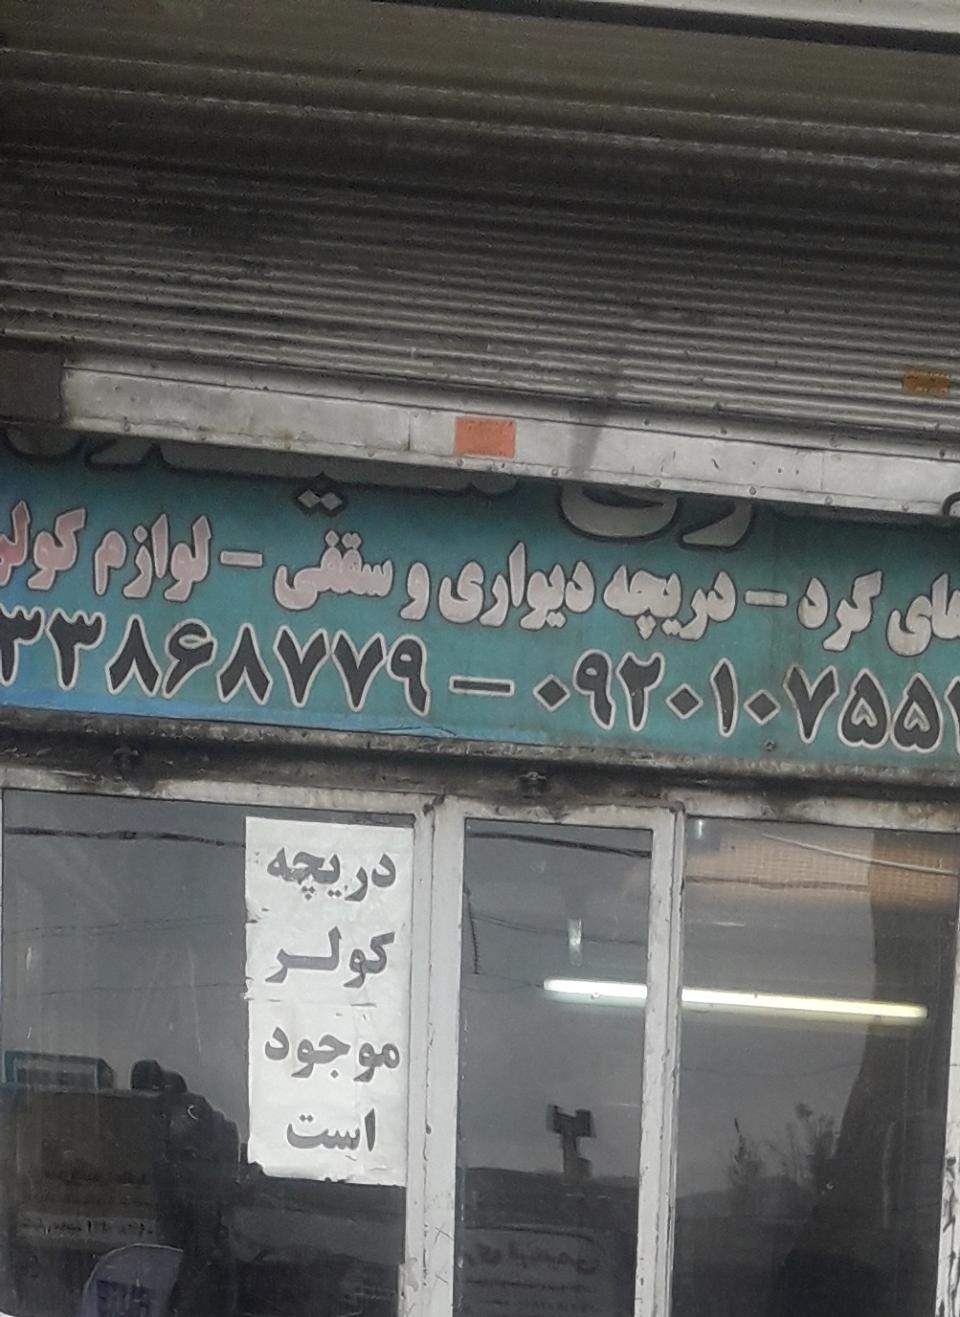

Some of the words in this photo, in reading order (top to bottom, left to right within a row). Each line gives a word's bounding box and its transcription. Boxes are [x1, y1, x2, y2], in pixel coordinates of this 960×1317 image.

[94, 512, 213, 603] لوازم
[273, 529, 395, 611] سقفی
[399, 561, 431, 621] و
[437, 540, 596, 631] دیواری
[603, 564, 737, 641] دریچه
[0, 602, 430, 717] ۳۳۸۶۸۷۷۹
[266, 846, 397, 901] دریچه
[265, 925, 395, 988] کولر
[264, 1025, 401, 1082] موجود
[286, 1108, 377, 1152] است
